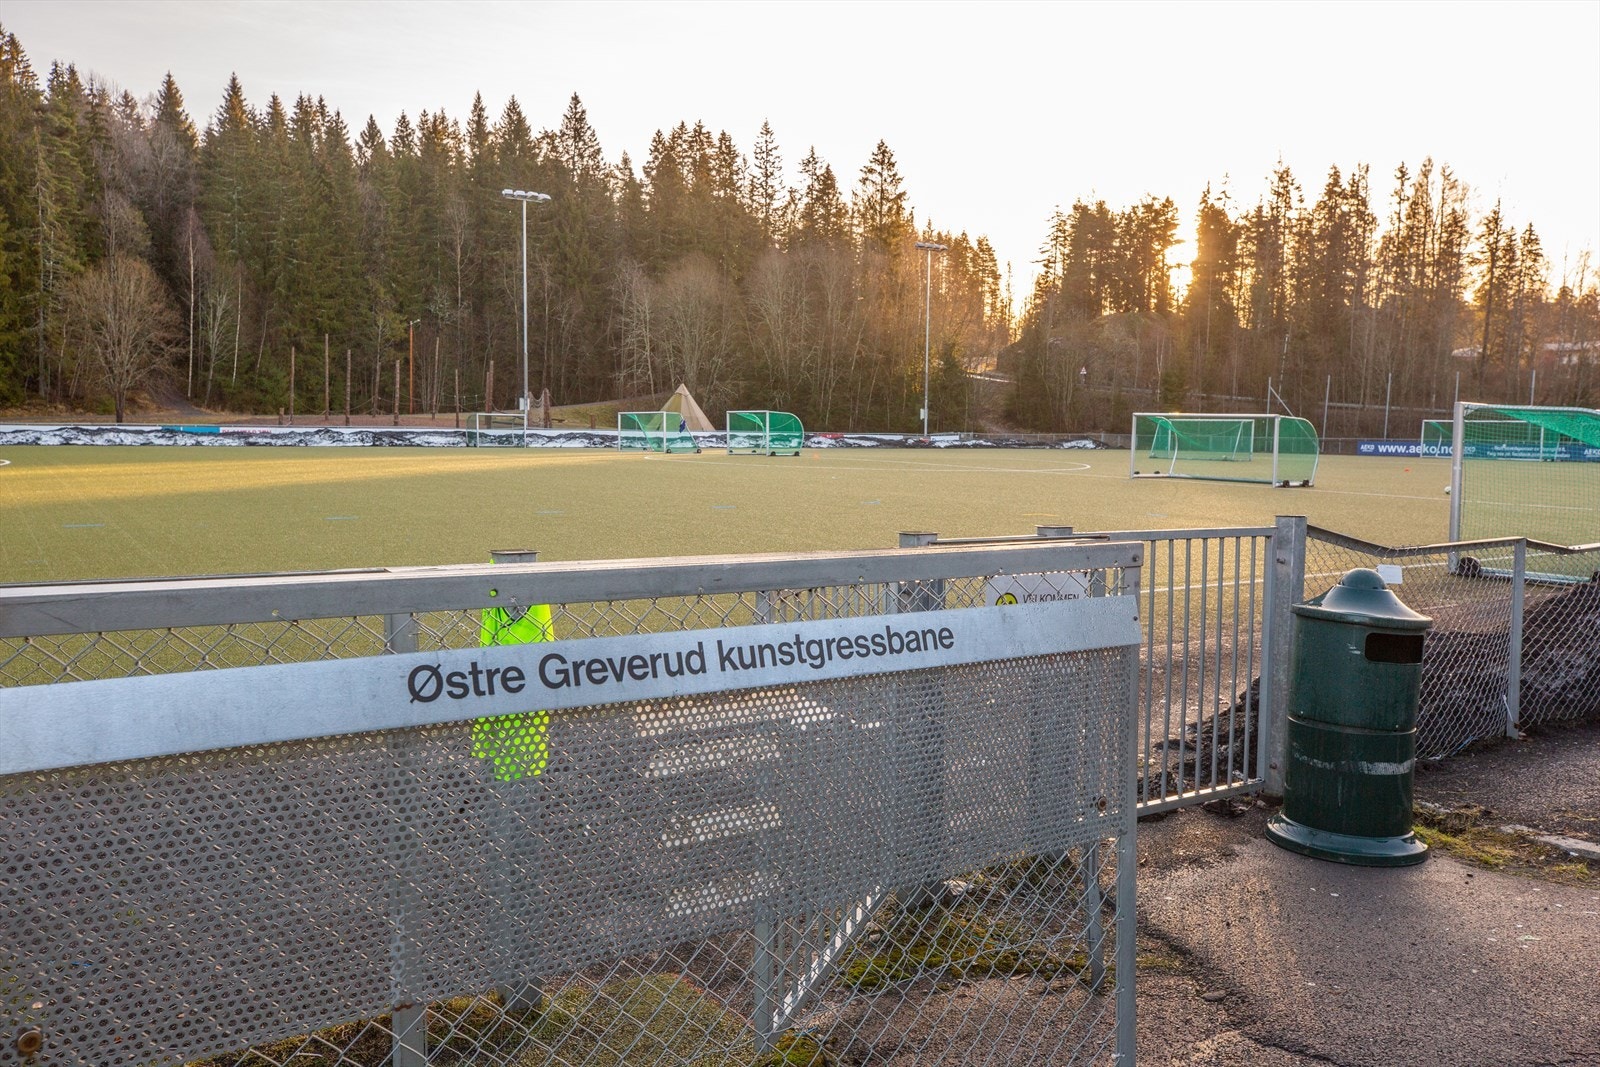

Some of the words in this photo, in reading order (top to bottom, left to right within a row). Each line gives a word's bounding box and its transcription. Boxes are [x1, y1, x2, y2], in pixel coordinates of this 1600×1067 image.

[407, 663, 526, 703] Østre
[538, 641, 707, 689] Greverud
[717, 625, 955, 672] kunstgressbane
